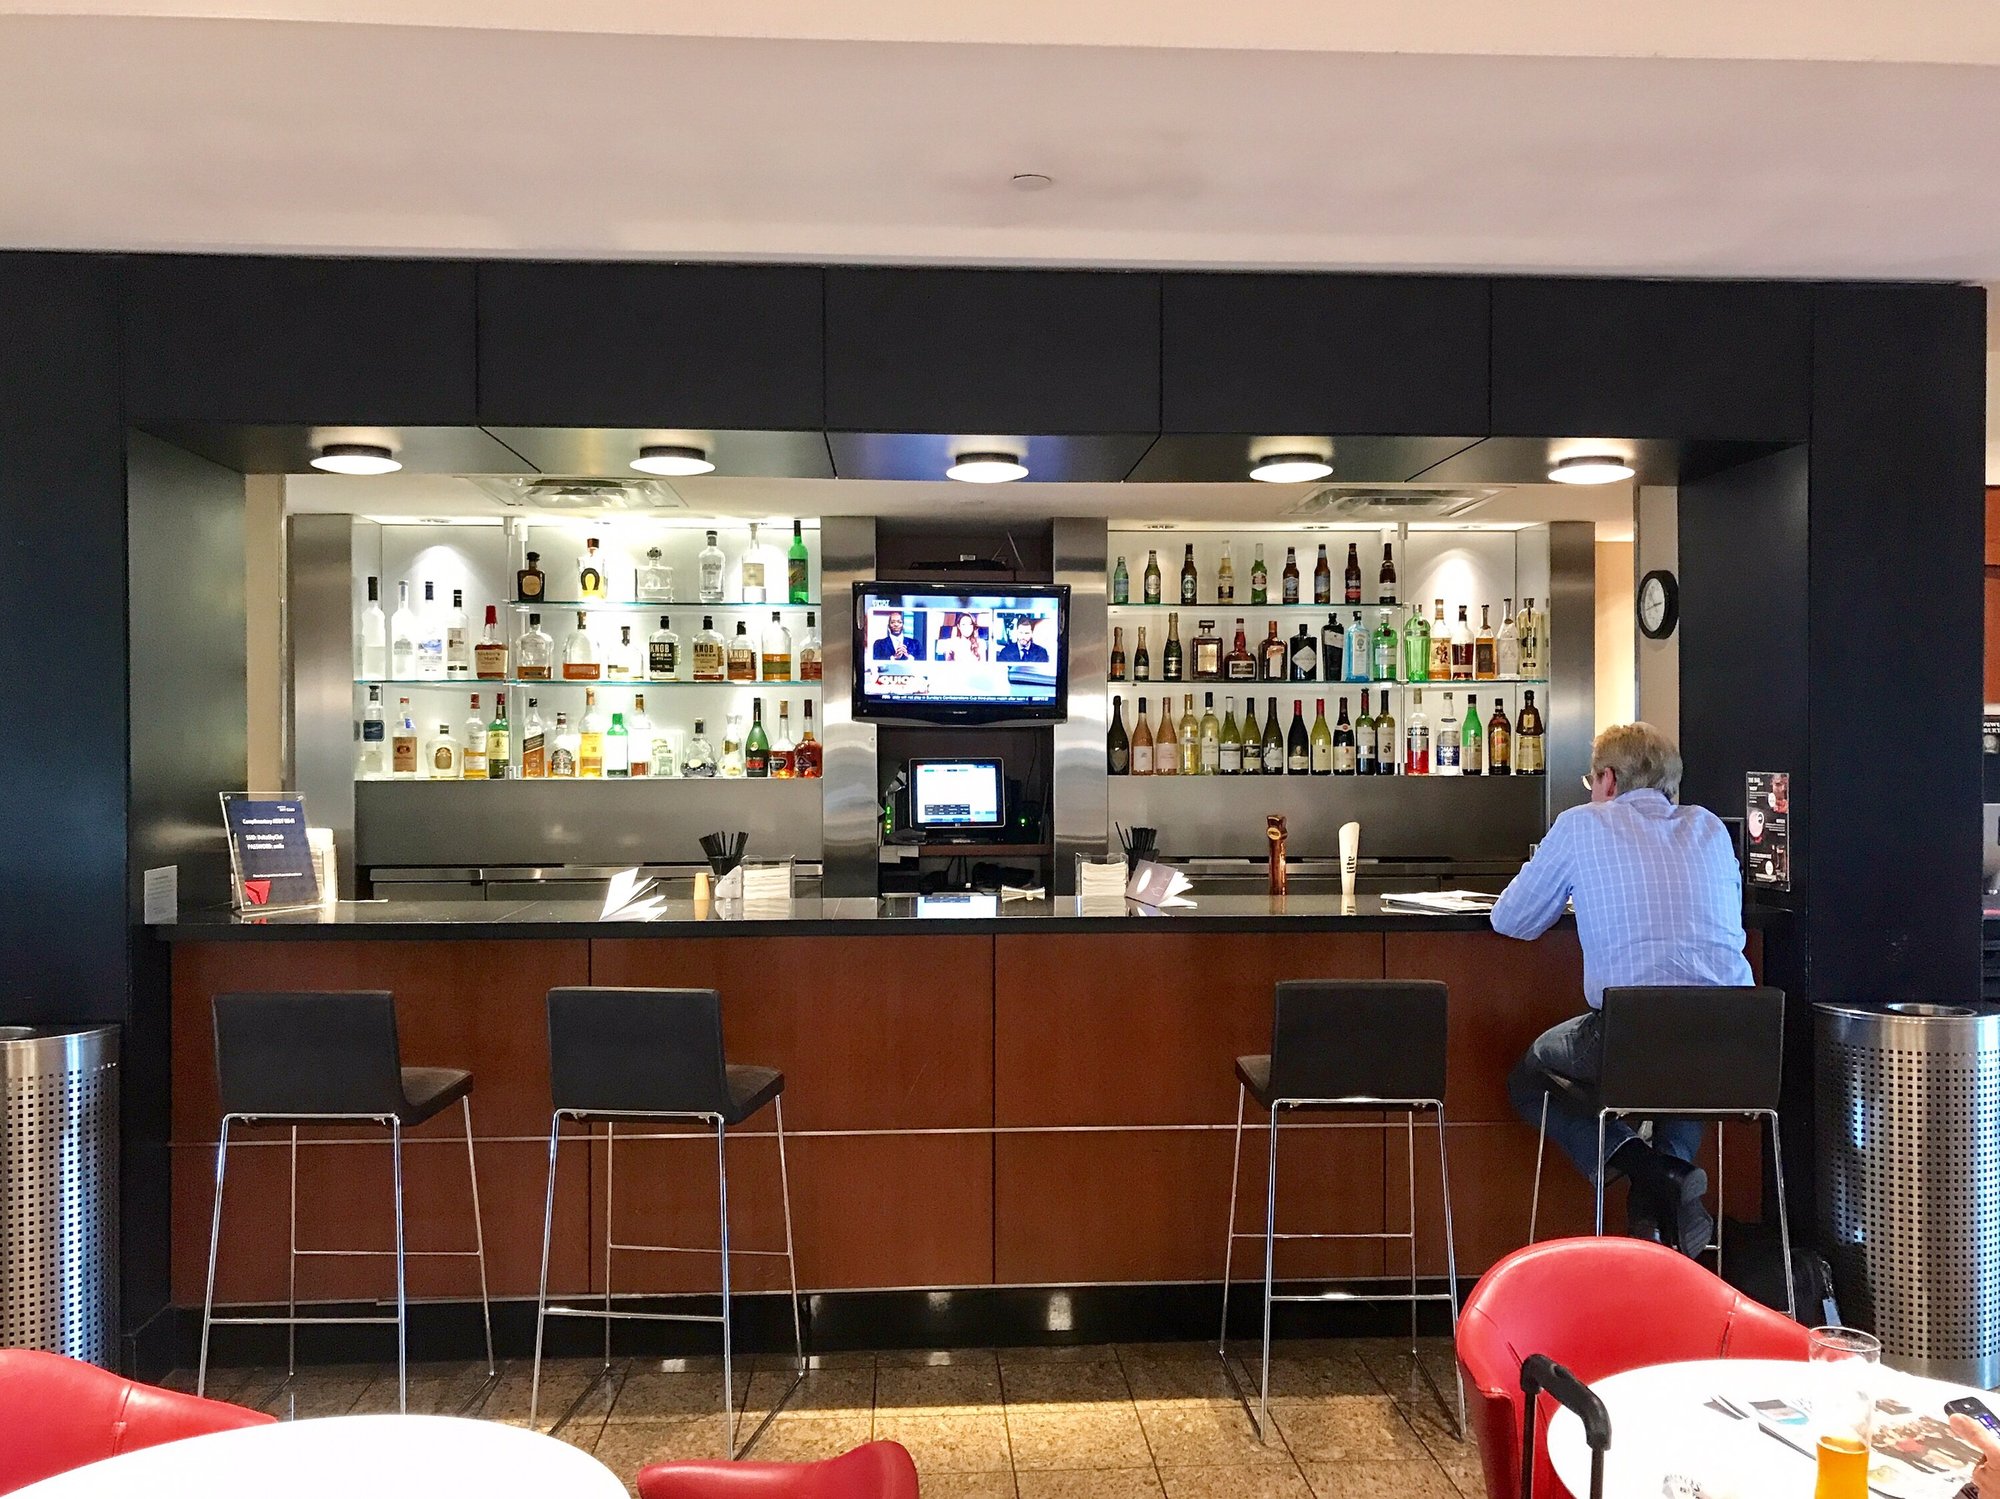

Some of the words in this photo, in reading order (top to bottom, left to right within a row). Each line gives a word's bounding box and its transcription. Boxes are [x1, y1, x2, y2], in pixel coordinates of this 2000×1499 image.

[650, 643, 670, 653] KNOB
[694, 644, 714, 653] KNOB
[1346, 855, 1356, 874] lite
